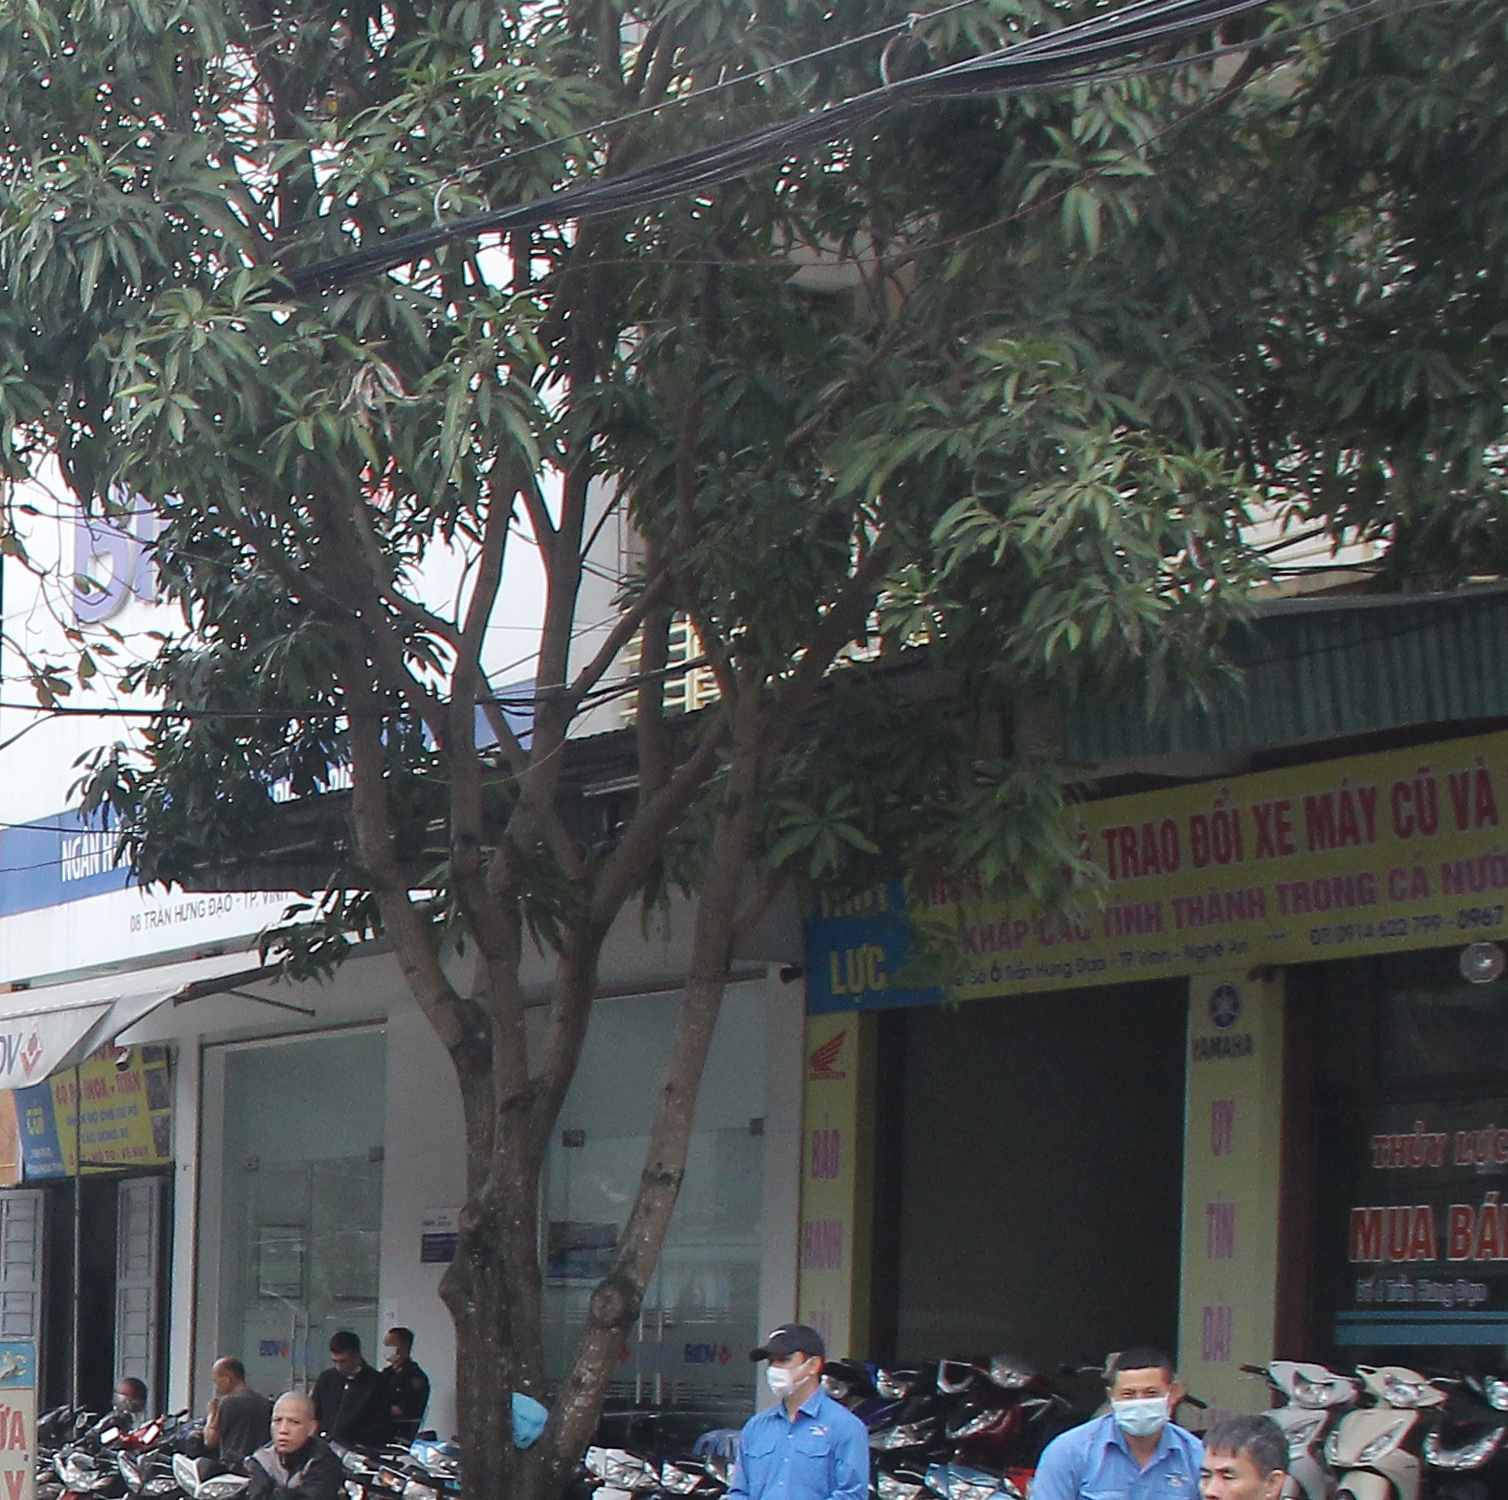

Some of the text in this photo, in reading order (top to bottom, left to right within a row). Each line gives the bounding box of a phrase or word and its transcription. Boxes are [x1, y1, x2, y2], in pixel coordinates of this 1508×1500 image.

[1101, 817, 1182, 881] TRAO
[1189, 786, 1244, 869] ĐỔI
[1252, 799, 1295, 860] XE
[1303, 777, 1379, 853] MÁY
[1390, 766, 1439, 840] CŨ
[1448, 755, 1500, 832] VÀ
[129, 914, 142, 933] 08
[174, 896, 206, 923] HƯNG
[207, 893, 233, 919] ĐẠO
[1103, 894, 1163, 939] TỈNH
[1171, 887, 1267, 930] THÀNH
[1275, 871, 1378, 916] TRONG
[1387, 850, 1431, 901] CẢ
[1441, 843, 1508, 897] NƯỚ
[829, 942, 887, 1004] LỰC
[989, 959, 1002, 982] 6
[1191, 1035, 1254, 1060] YAMAHA
[1371, 1120, 1448, 1168] THỦY
[1348, 1190, 1508, 1263] MUA BÁ
